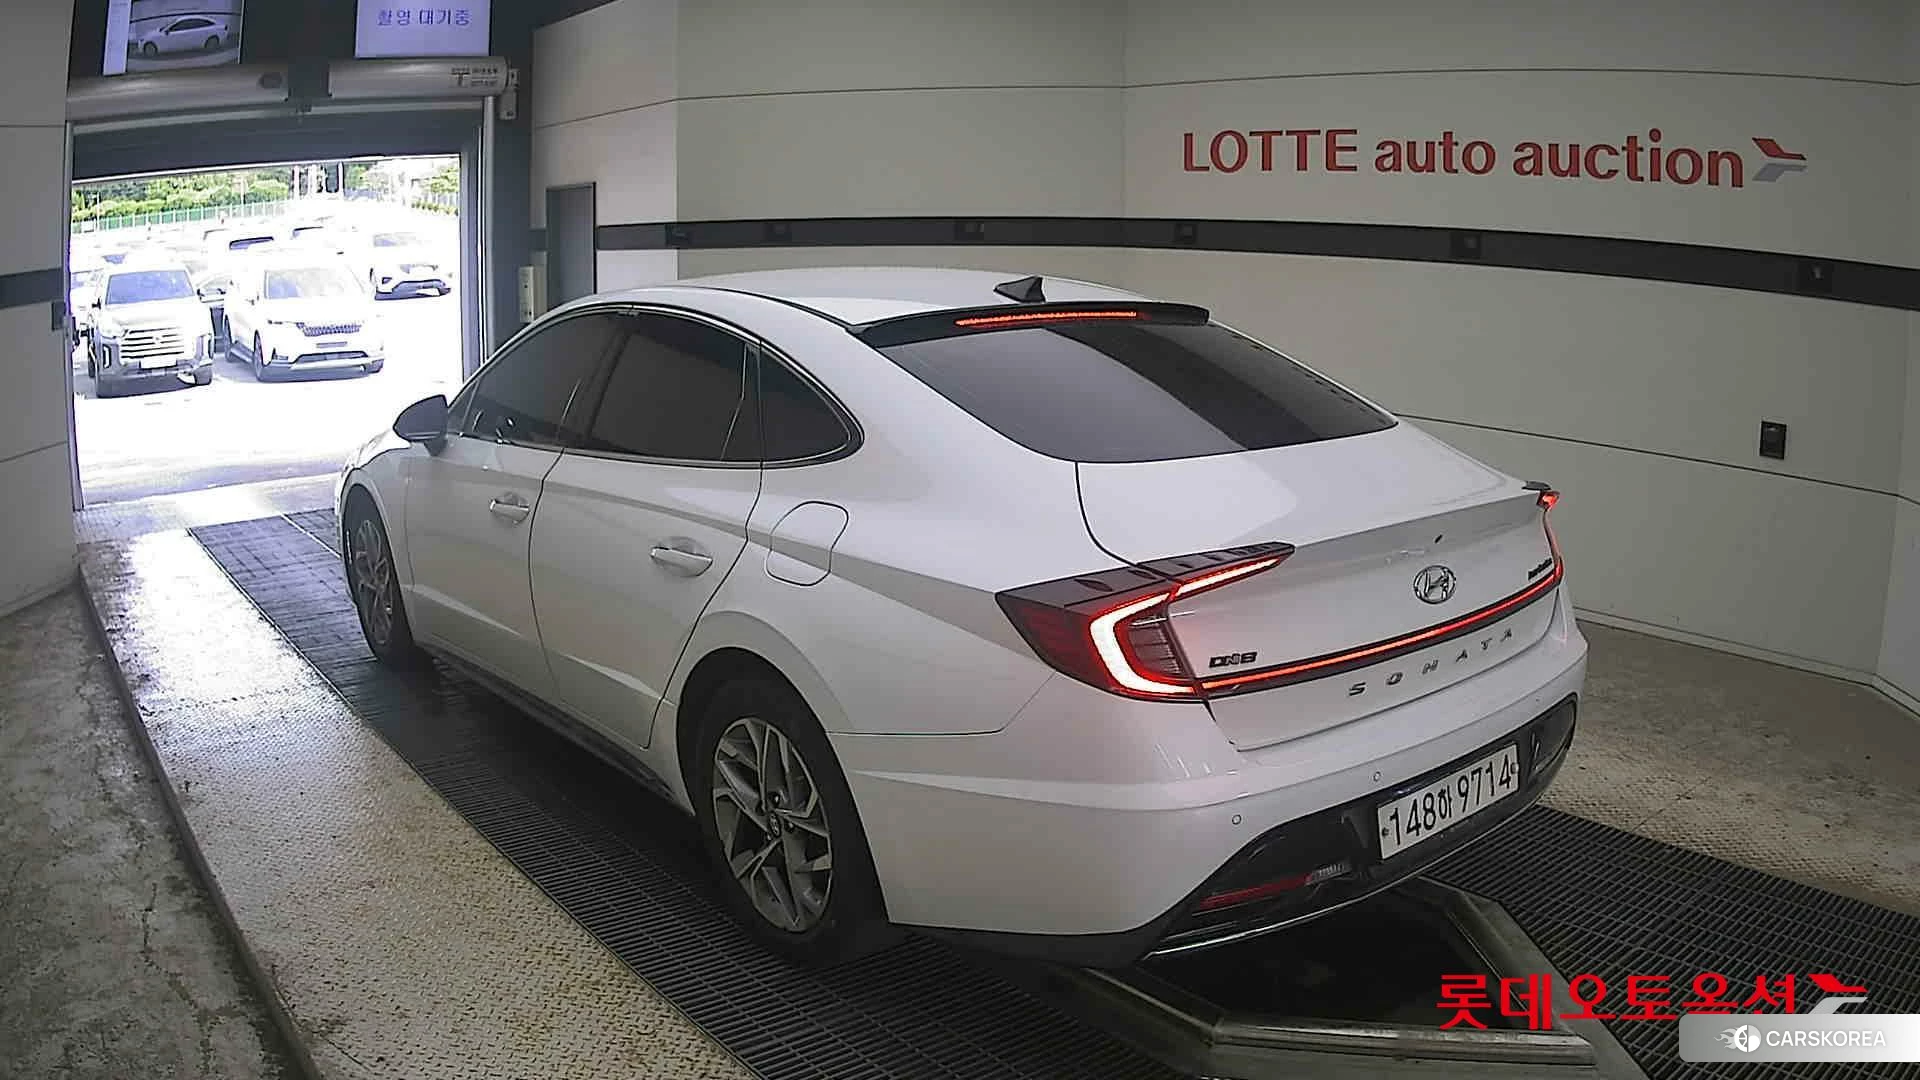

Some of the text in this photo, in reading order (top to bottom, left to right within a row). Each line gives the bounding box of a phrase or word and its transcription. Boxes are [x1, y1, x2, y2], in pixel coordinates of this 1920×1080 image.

[419, 9, 470, 26] 대기중
[1183, 128, 1744, 188] LOTTE auto auction
[1348, 627, 1513, 697] SONATA
